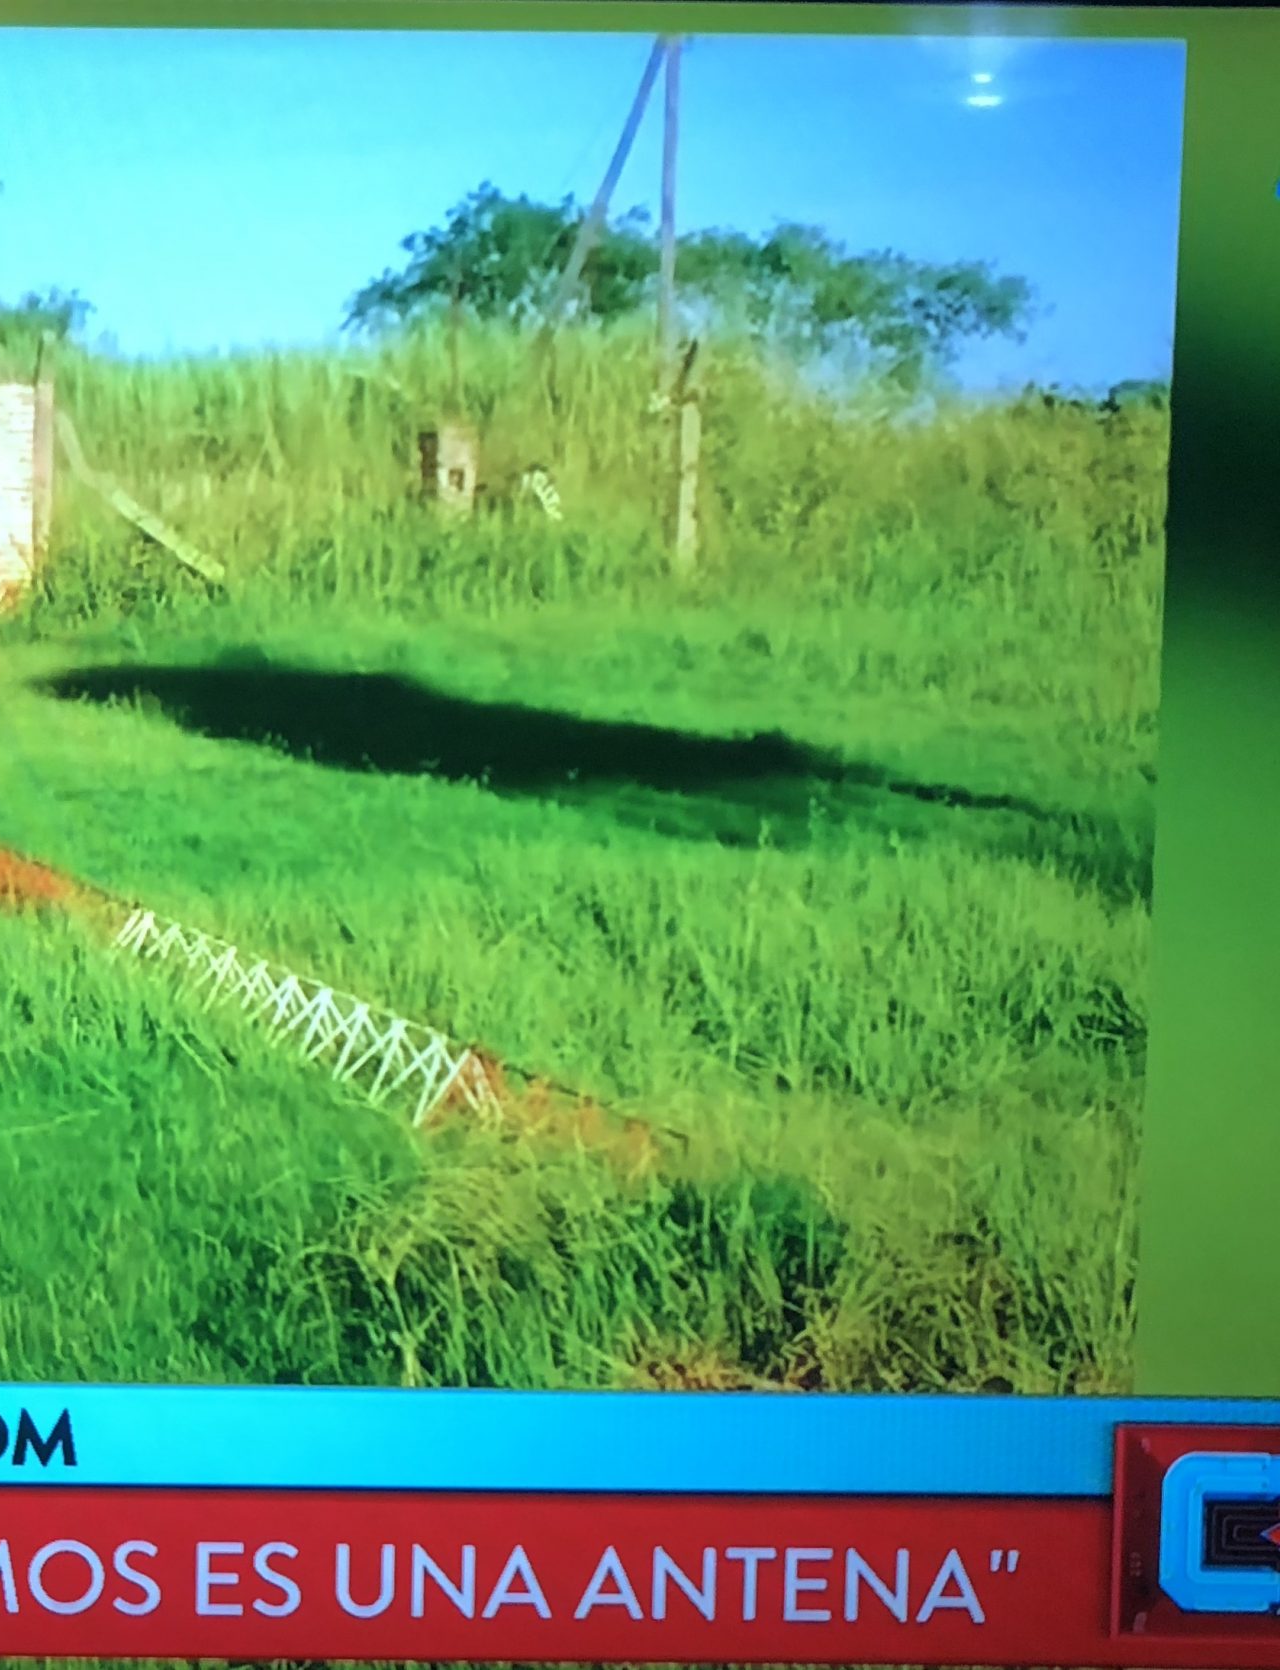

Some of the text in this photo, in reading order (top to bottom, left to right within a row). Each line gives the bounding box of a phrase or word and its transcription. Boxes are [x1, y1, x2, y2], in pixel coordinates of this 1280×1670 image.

[195, 1540, 302, 1617] ES
[336, 1543, 552, 1619] UNA
[573, 1546, 1020, 1624] ANTENA"
